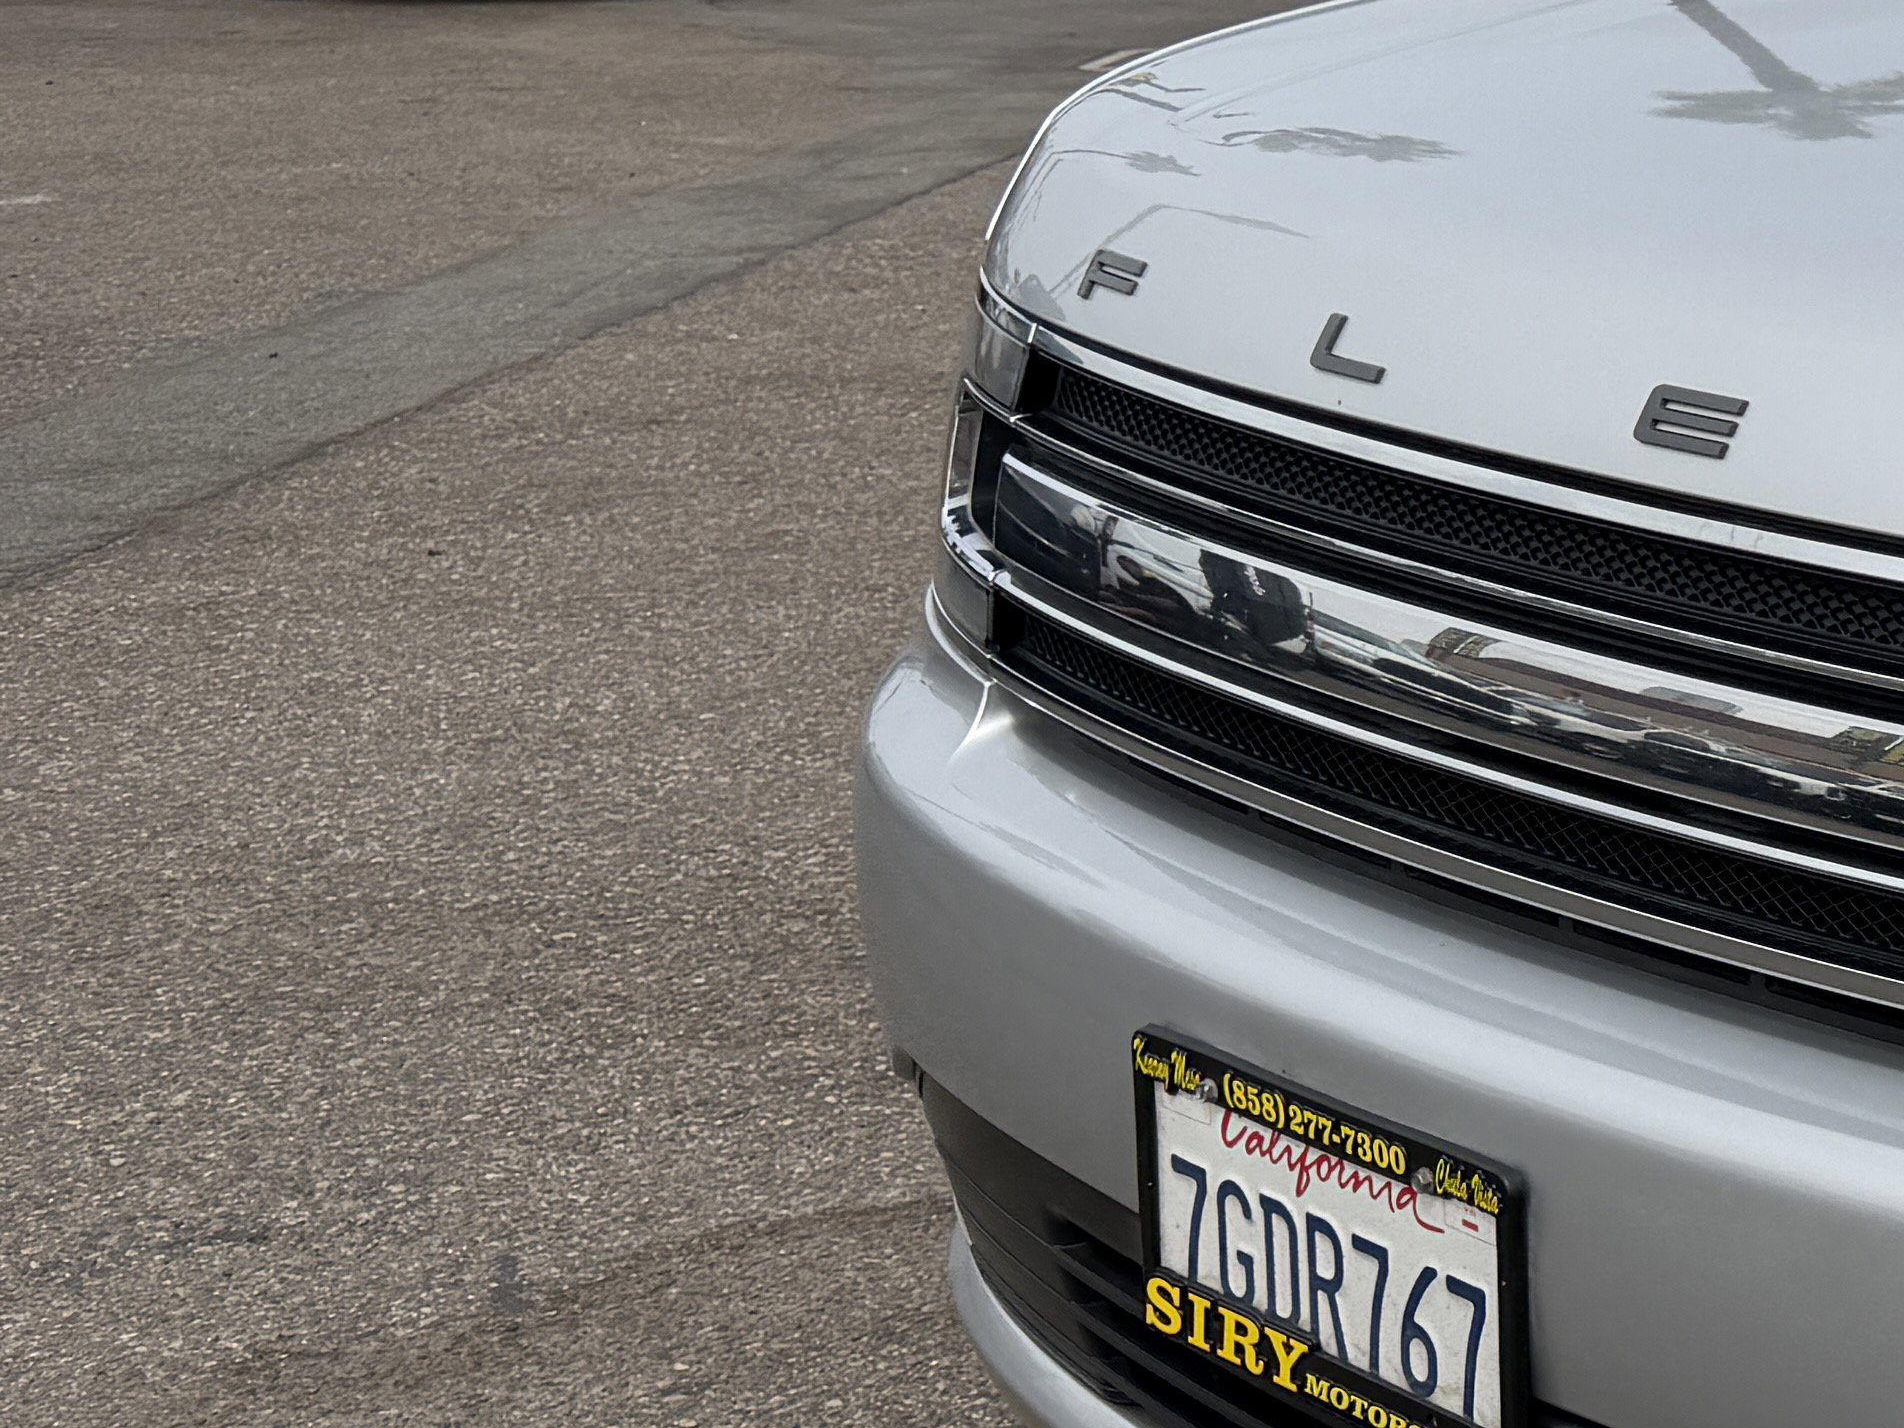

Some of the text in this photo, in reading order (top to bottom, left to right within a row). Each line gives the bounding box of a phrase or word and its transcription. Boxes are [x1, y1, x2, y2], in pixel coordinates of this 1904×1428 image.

[1220, 1110, 1445, 1234] California
[1223, 1072, 1407, 1176] (858) 277-7300
[1145, 1276, 1309, 1393] SIRY
[1171, 1153, 1487, 1425] 7GDR767
